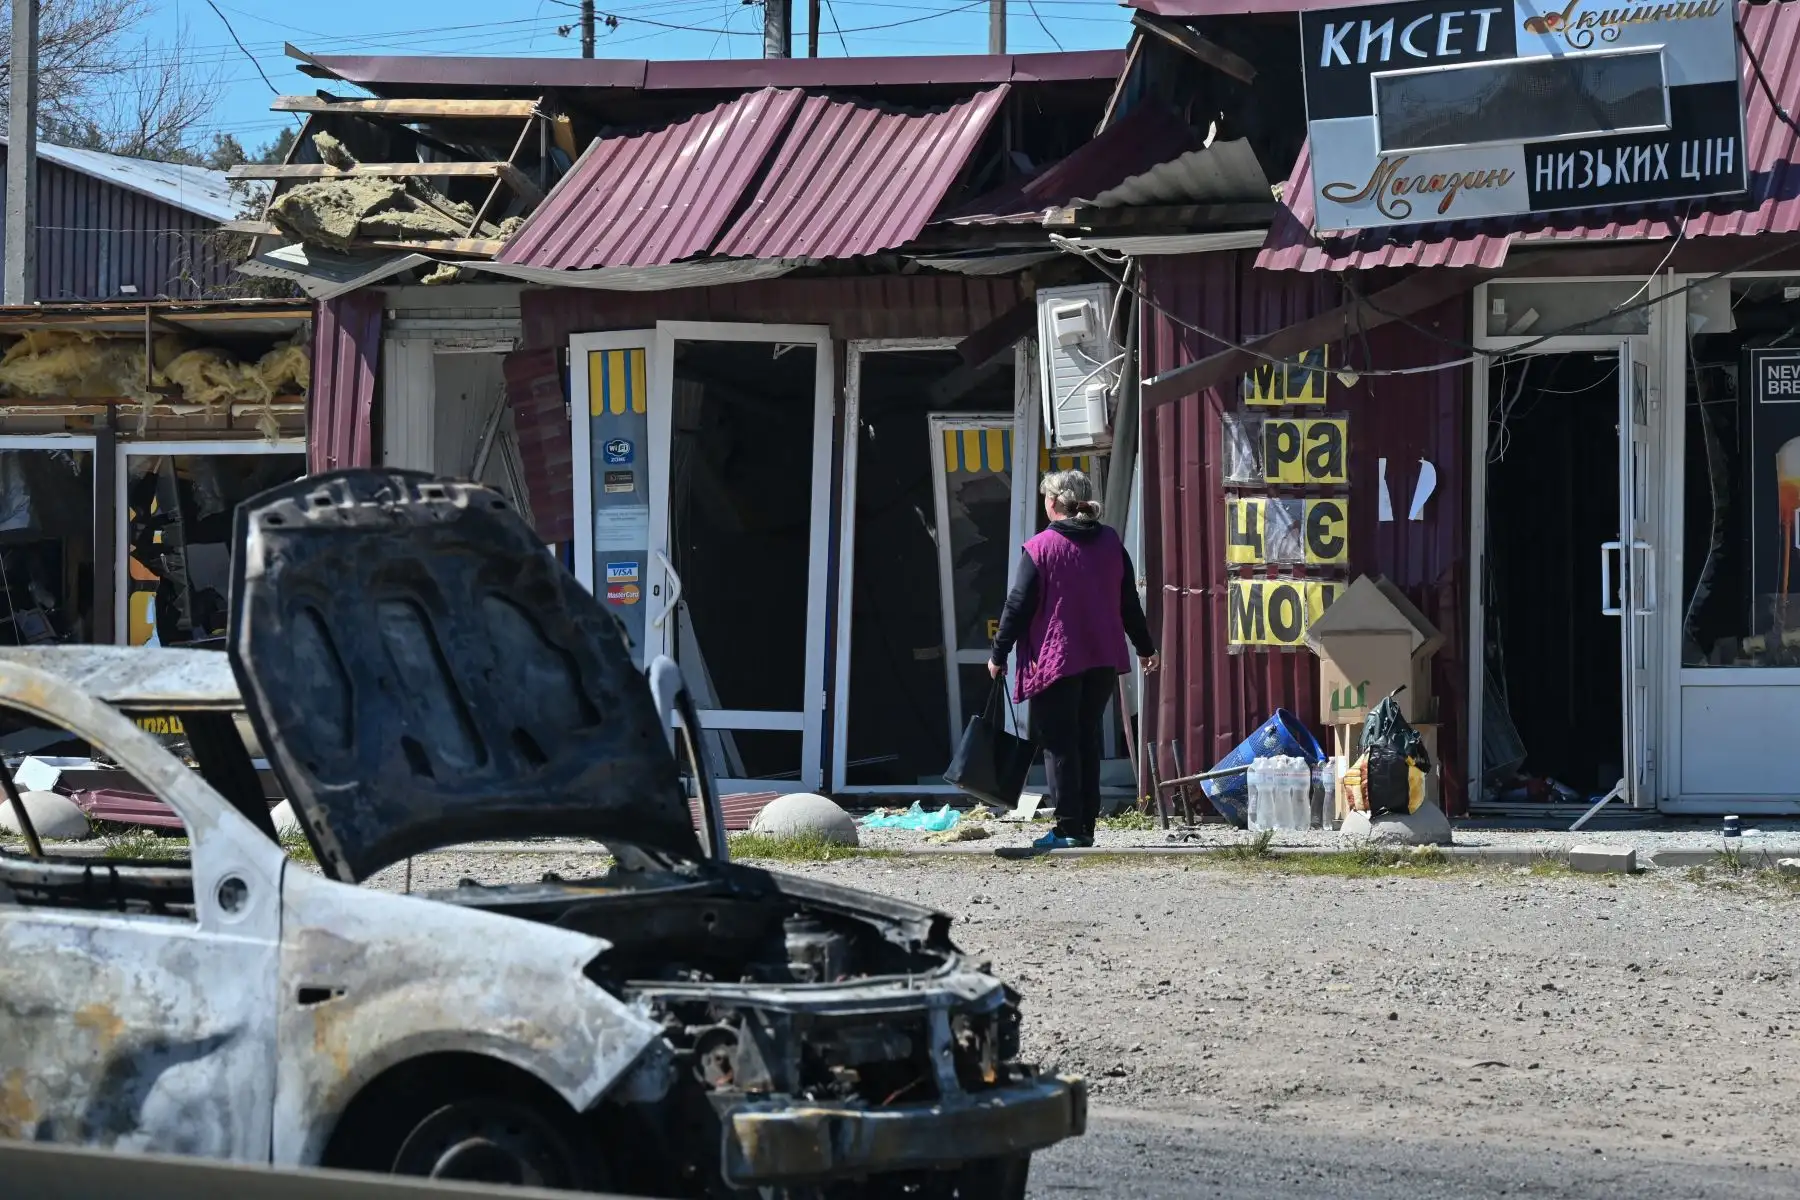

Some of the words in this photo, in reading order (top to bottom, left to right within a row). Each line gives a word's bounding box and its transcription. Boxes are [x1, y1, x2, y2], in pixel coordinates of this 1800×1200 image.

[1320, 8, 1502, 68] КИСЕТ
[1322, 156, 1516, 220] Магазин
[1535, 144, 1670, 193] НИЗЬКИХ
[1681, 137, 1735, 181] ЦІН
[607, 591, 640, 600] MasterCard
[612, 568, 633, 577] VISA
